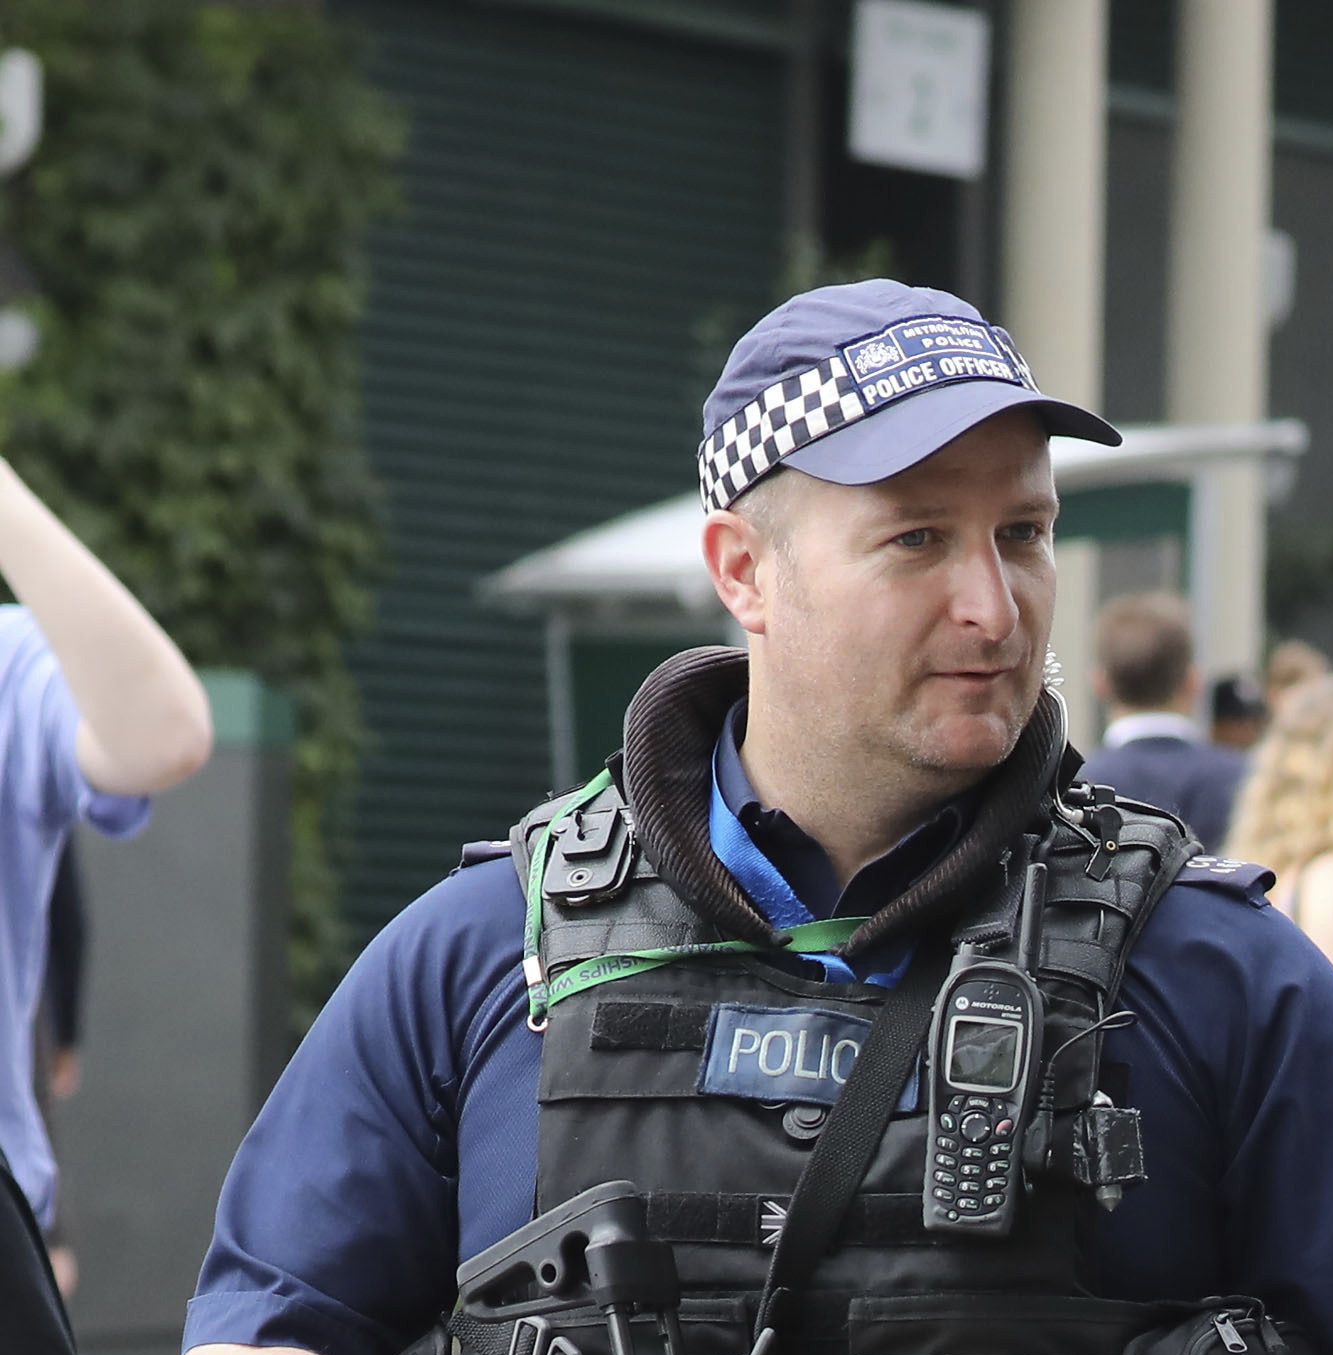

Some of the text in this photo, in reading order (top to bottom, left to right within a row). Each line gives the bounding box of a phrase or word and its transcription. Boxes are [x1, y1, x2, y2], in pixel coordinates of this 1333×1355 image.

[921, 335, 984, 350] POLICE
[862, 356, 1015, 406] POLICE OFFICER
[971, 1001, 1022, 1012] MOTOROLA
[728, 1028, 861, 1085] POLIC
